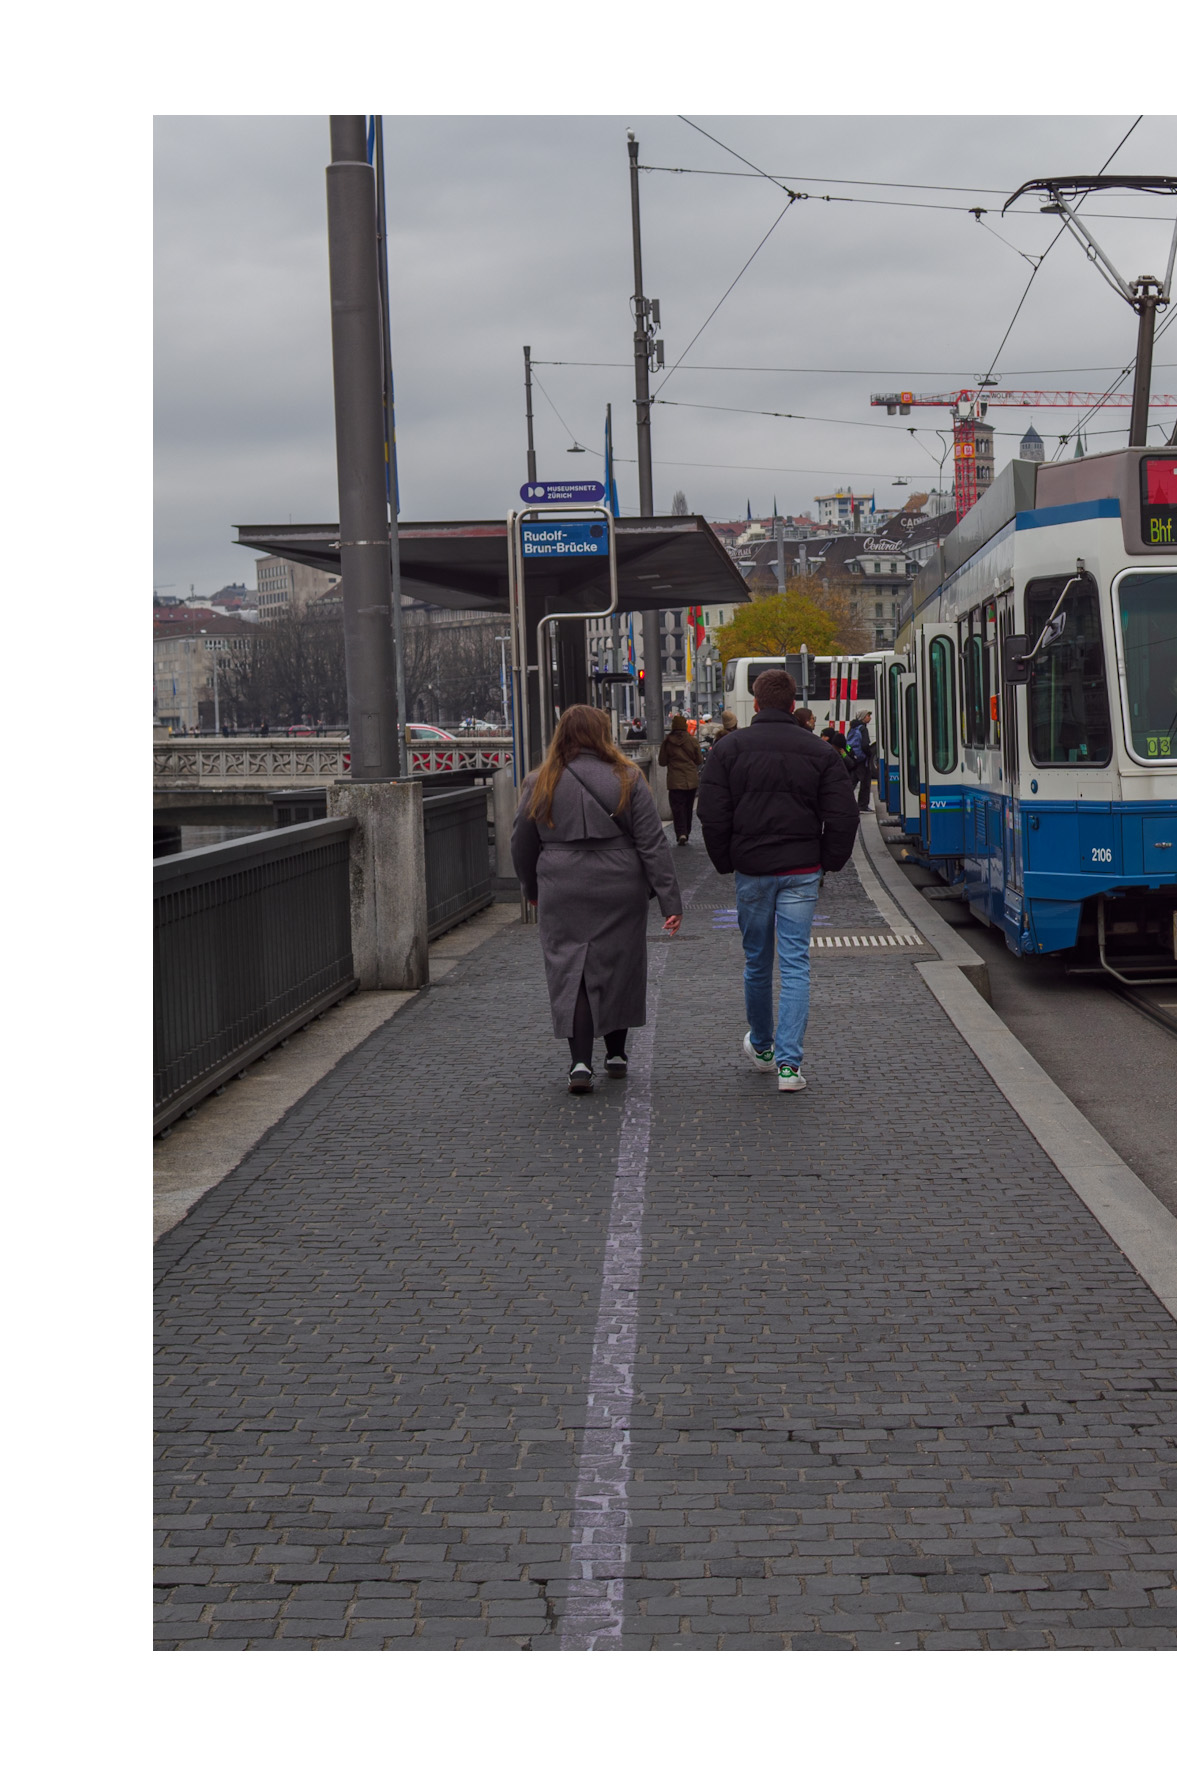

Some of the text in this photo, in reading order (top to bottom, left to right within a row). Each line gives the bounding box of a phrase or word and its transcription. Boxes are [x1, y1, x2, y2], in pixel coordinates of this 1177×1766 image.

[523, 530, 568, 541] Rudolf-
[1150, 517, 1175, 542] Bhf.
[524, 542, 598, 554] Brun-Brücke
[863, 537, 903, 550] Central
[1091, 848, 1112, 862] 2106
